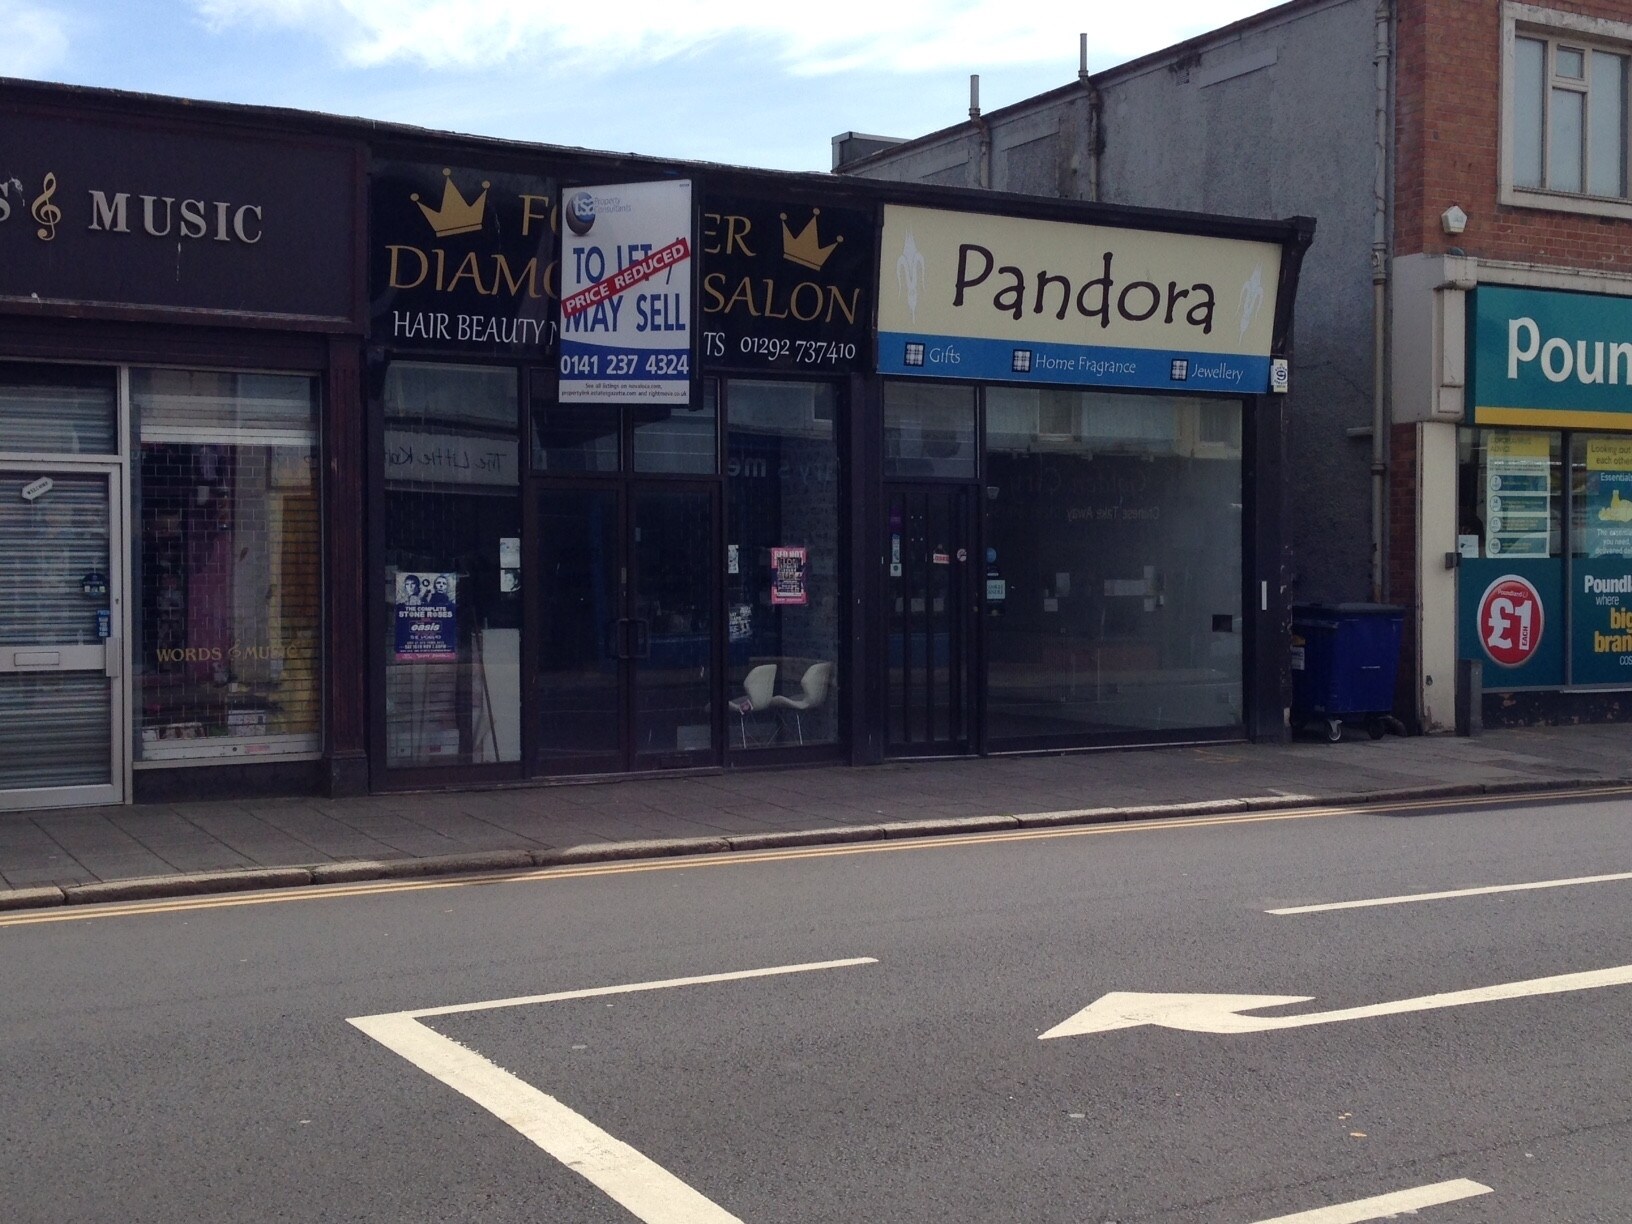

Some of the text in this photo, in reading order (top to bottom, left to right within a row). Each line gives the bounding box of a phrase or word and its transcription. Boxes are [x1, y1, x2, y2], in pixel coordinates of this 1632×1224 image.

[88, 190, 262, 244] MUSIC
[573, 246, 606, 284] TO
[566, 244, 686, 313] PRICE REDUCED
[952, 244, 1216, 335] Pandora
[703, 273, 860, 325] SALON
[565, 293, 686, 332] MAY SELL
[393, 310, 451, 339] HAIR
[457, 314, 545, 344] BEAUTY
[740, 336, 790, 361] 01292
[795, 340, 856, 365] 737410
[929, 345, 961, 365] Gifts
[560, 354, 689, 375] 0141 237 4324
[1035, 354, 1137, 377] Home Fragrance
[1191, 362, 1245, 385] Jewellery
[1590, 444, 1618, 455] Looking
[1595, 457, 1613, 465] each
[1584, 574, 1632, 594] Poundl
[1595, 594, 1620, 606] where
[410, 623, 441, 631] oasis
[1487, 597, 1533, 651] £1
[1610, 607, 1632, 634] big
[156, 647, 223, 663] WORDS
